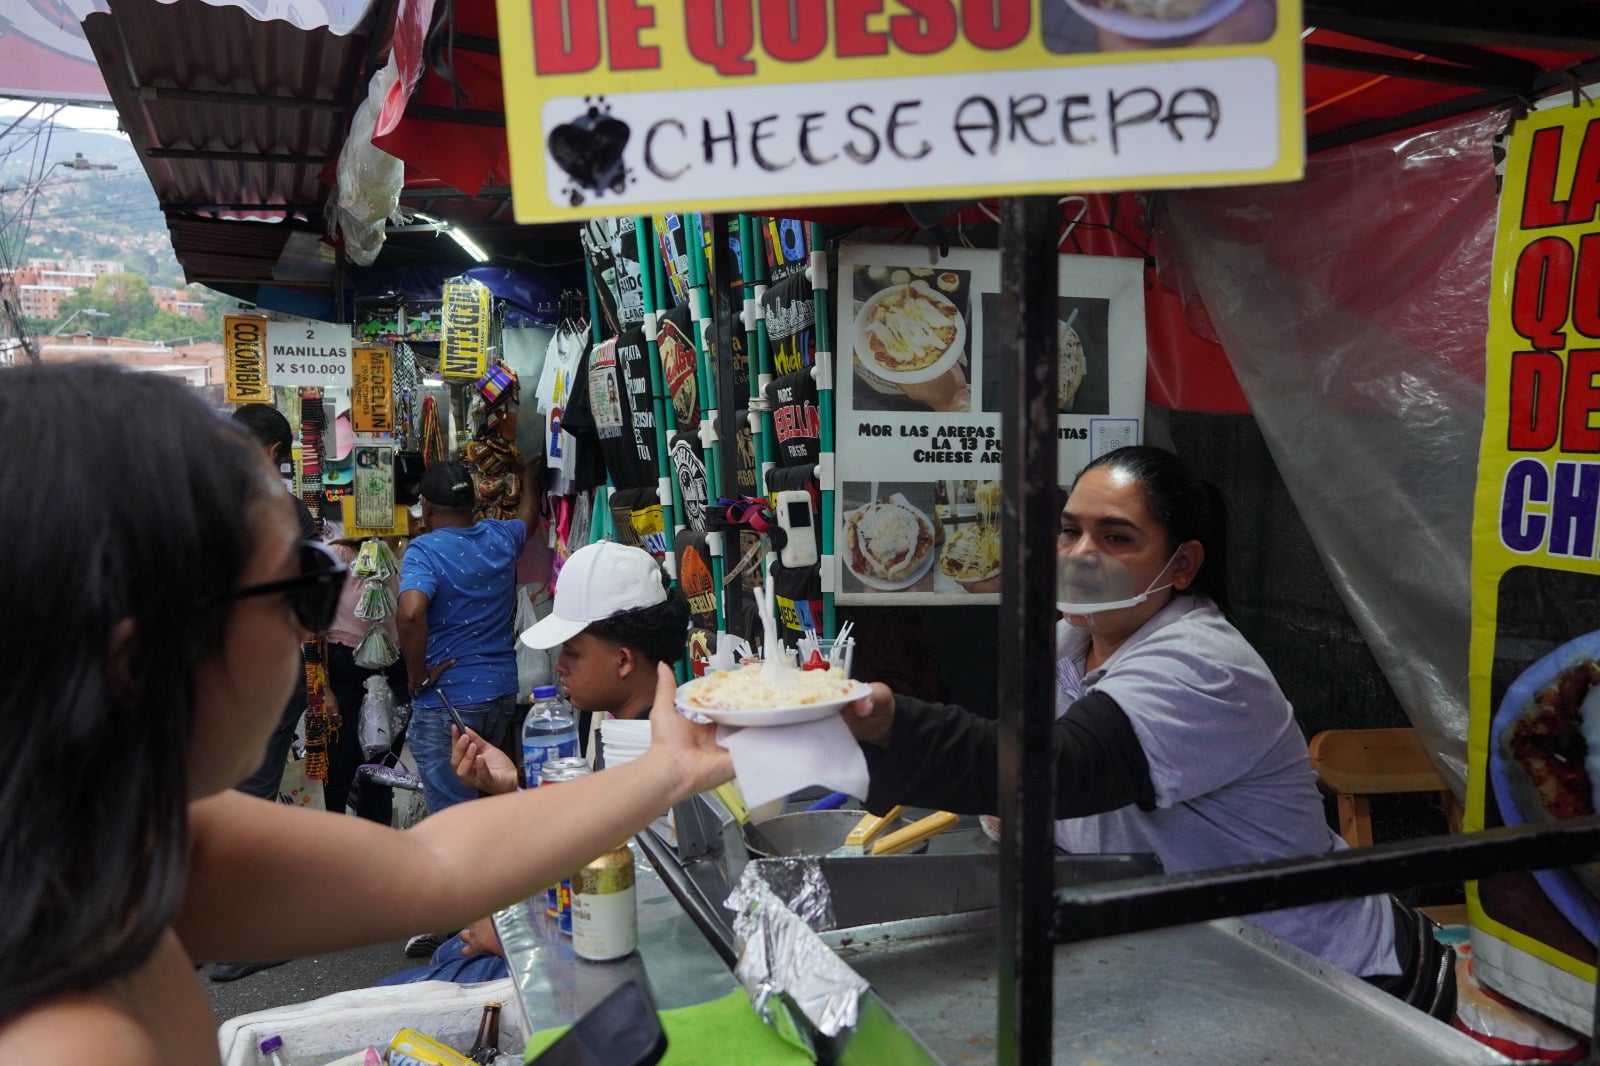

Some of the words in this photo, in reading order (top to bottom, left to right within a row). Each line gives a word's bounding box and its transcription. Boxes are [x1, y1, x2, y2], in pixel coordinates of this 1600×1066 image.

[532, 0, 662, 77] DE
[643, 100, 932, 181] CHEESE
[953, 87, 1222, 158] AREPA
[306, 329, 315, 340] 2
[273, 345, 347, 357] MANILLAS
[234, 322, 261, 398] COLOMBIA
[276, 363, 285, 373] X
[290, 363, 345, 375] $10.000
[370, 352, 386, 429] MEDELLIN
[858, 422, 893, 437] MOR
[900, 425, 929, 438] LAS
[936, 426, 995, 439] AREPAS
[1057, 427, 1088, 440] ITAS
[931, 437, 951, 450] LA
[960, 437, 977, 450] 13
[985, 438, 1003, 451] PU
[913, 449, 974, 463] CHEESE
[980, 451, 1003, 463] AR
